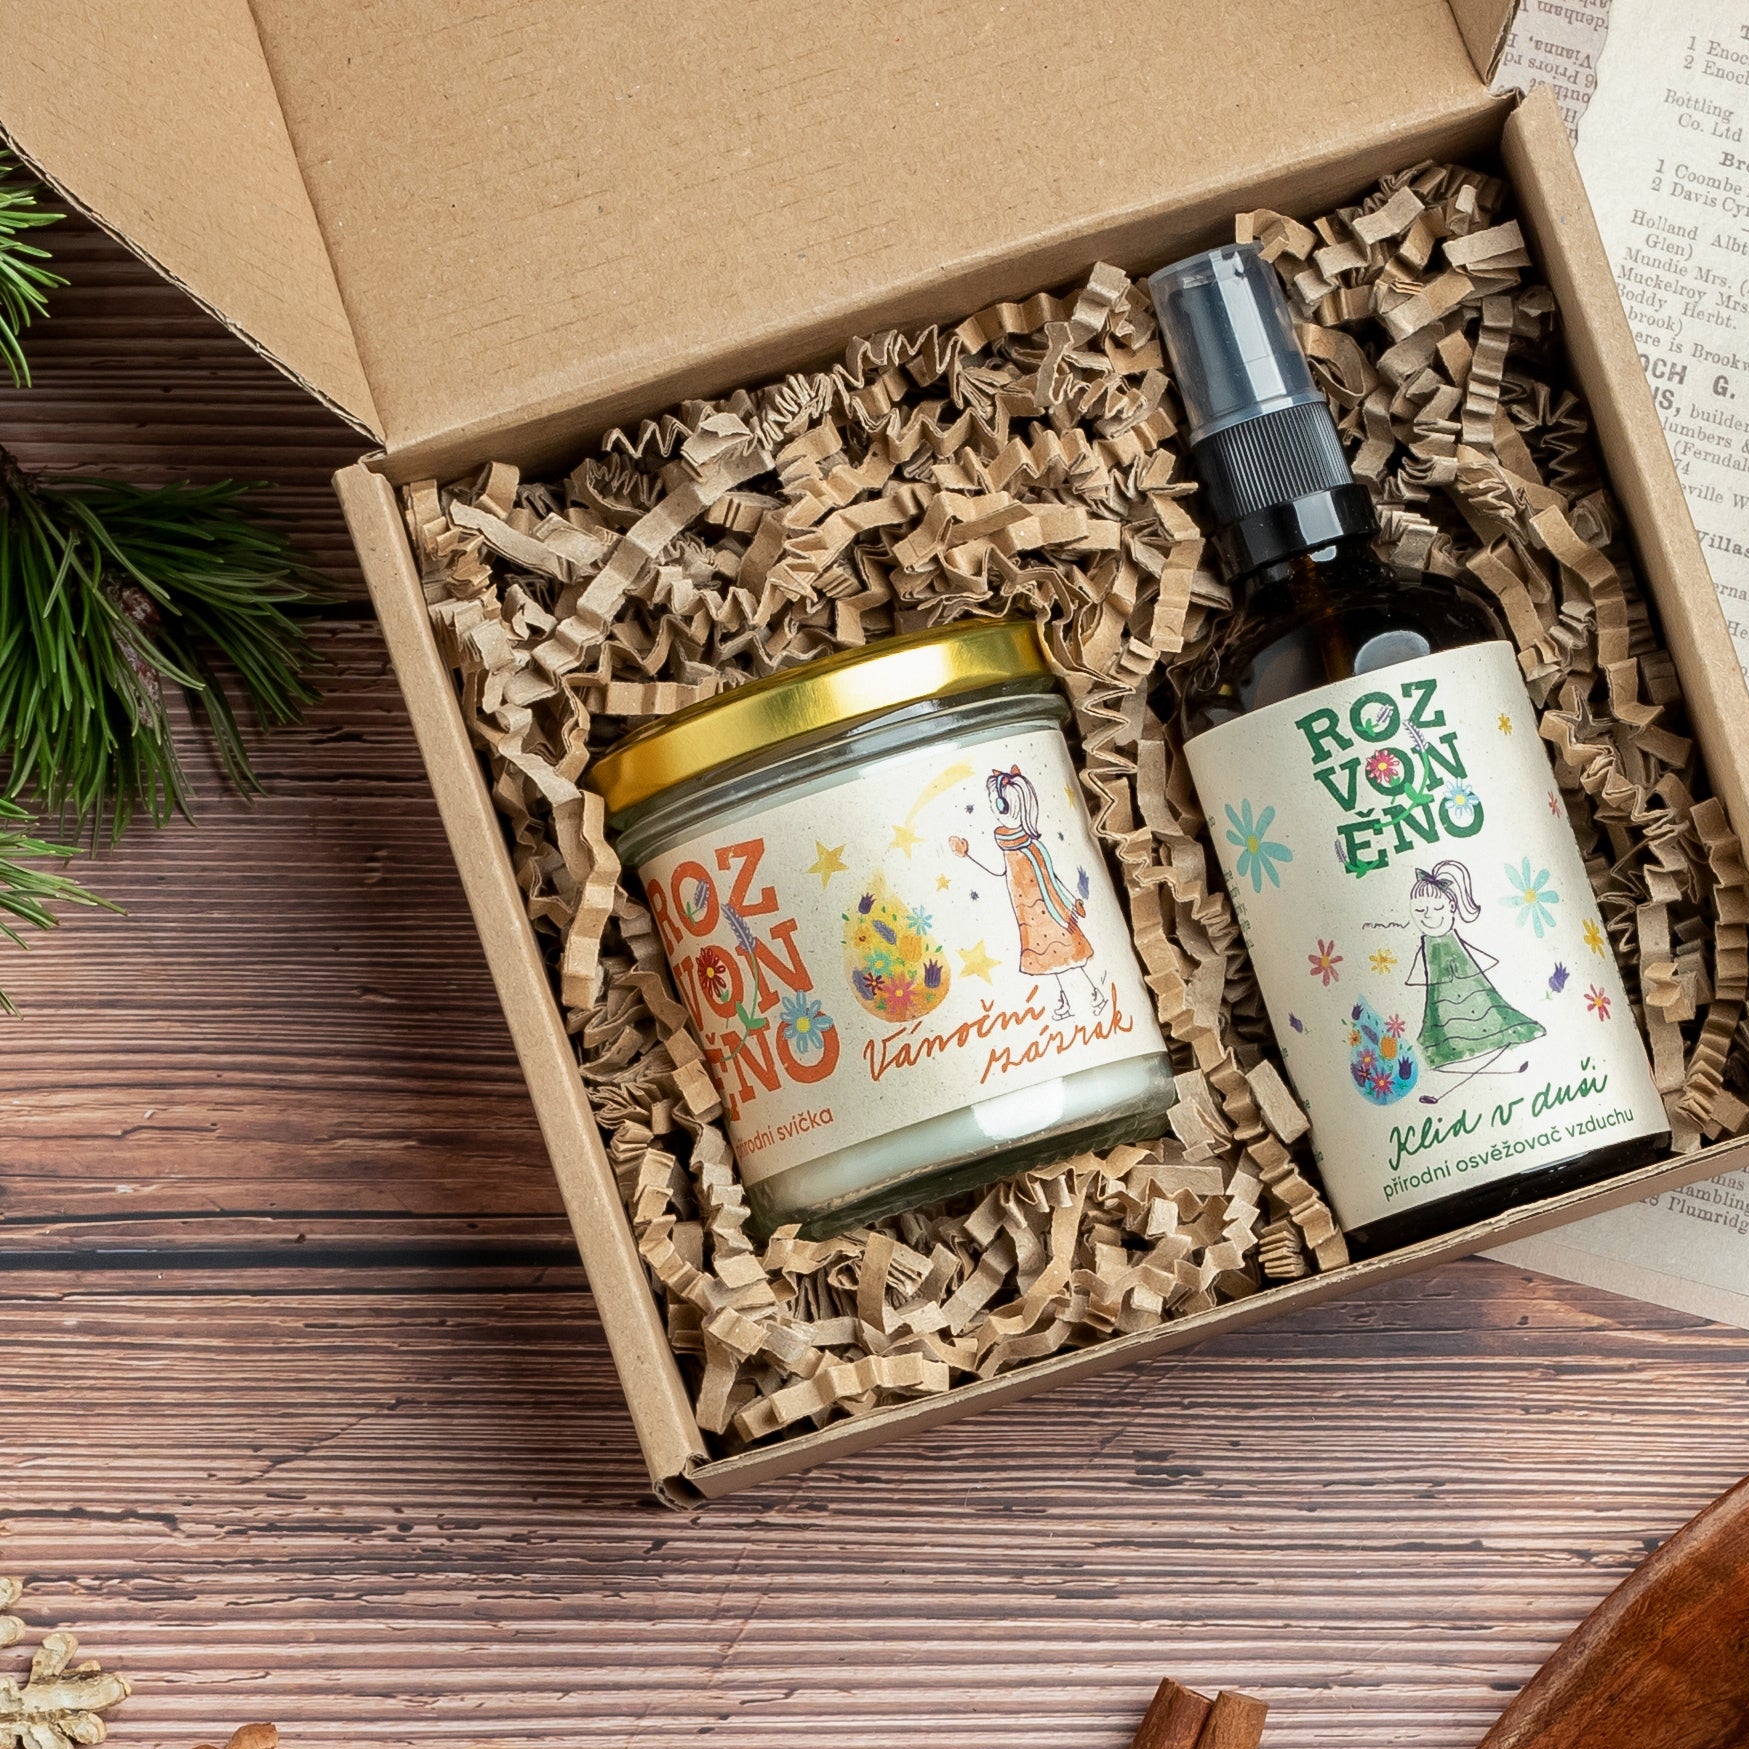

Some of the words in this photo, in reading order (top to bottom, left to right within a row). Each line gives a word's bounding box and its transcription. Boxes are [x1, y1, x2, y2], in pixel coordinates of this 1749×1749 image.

[1528, 35, 1593, 70] Vianna,
[1527, 58, 1580, 86] Priors
[1662, 87, 1735, 125] Bottling
[1677, 112, 1704, 133] Co.
[1710, 120, 1743, 144] Ltd
[1668, 180, 1718, 208] Davis
[1674, 163, 1743, 196] Coombe
[1629, 208, 1699, 241] Holland
[1644, 232, 1694, 262] Glen)
[1616, 263, 1708, 307] Muckelroy
[1622, 245, 1688, 278] Mundie
[1692, 265, 1732, 290] Mrs.
[1680, 300, 1737, 330] Herbt.
[1711, 373, 1736, 400] G.
[1294, 678, 1446, 765] ROZ
[1313, 731, 1468, 812] VON
[647, 837, 779, 955] ROZ
[863, 984, 1046, 1081] Vánoční
[981, 982, 1133, 1084] zázrak
[776, 1108, 834, 1141] svíčka
[1388, 1108, 1482, 1171] Klid
[1491, 1097, 1524, 1126] v
[1531, 1056, 1608, 1117] duši
[1383, 1160, 1451, 1201] přírodní
[1456, 1126, 1562, 1172] osvěžovač
[1565, 1108, 1634, 1138] vzduchu
